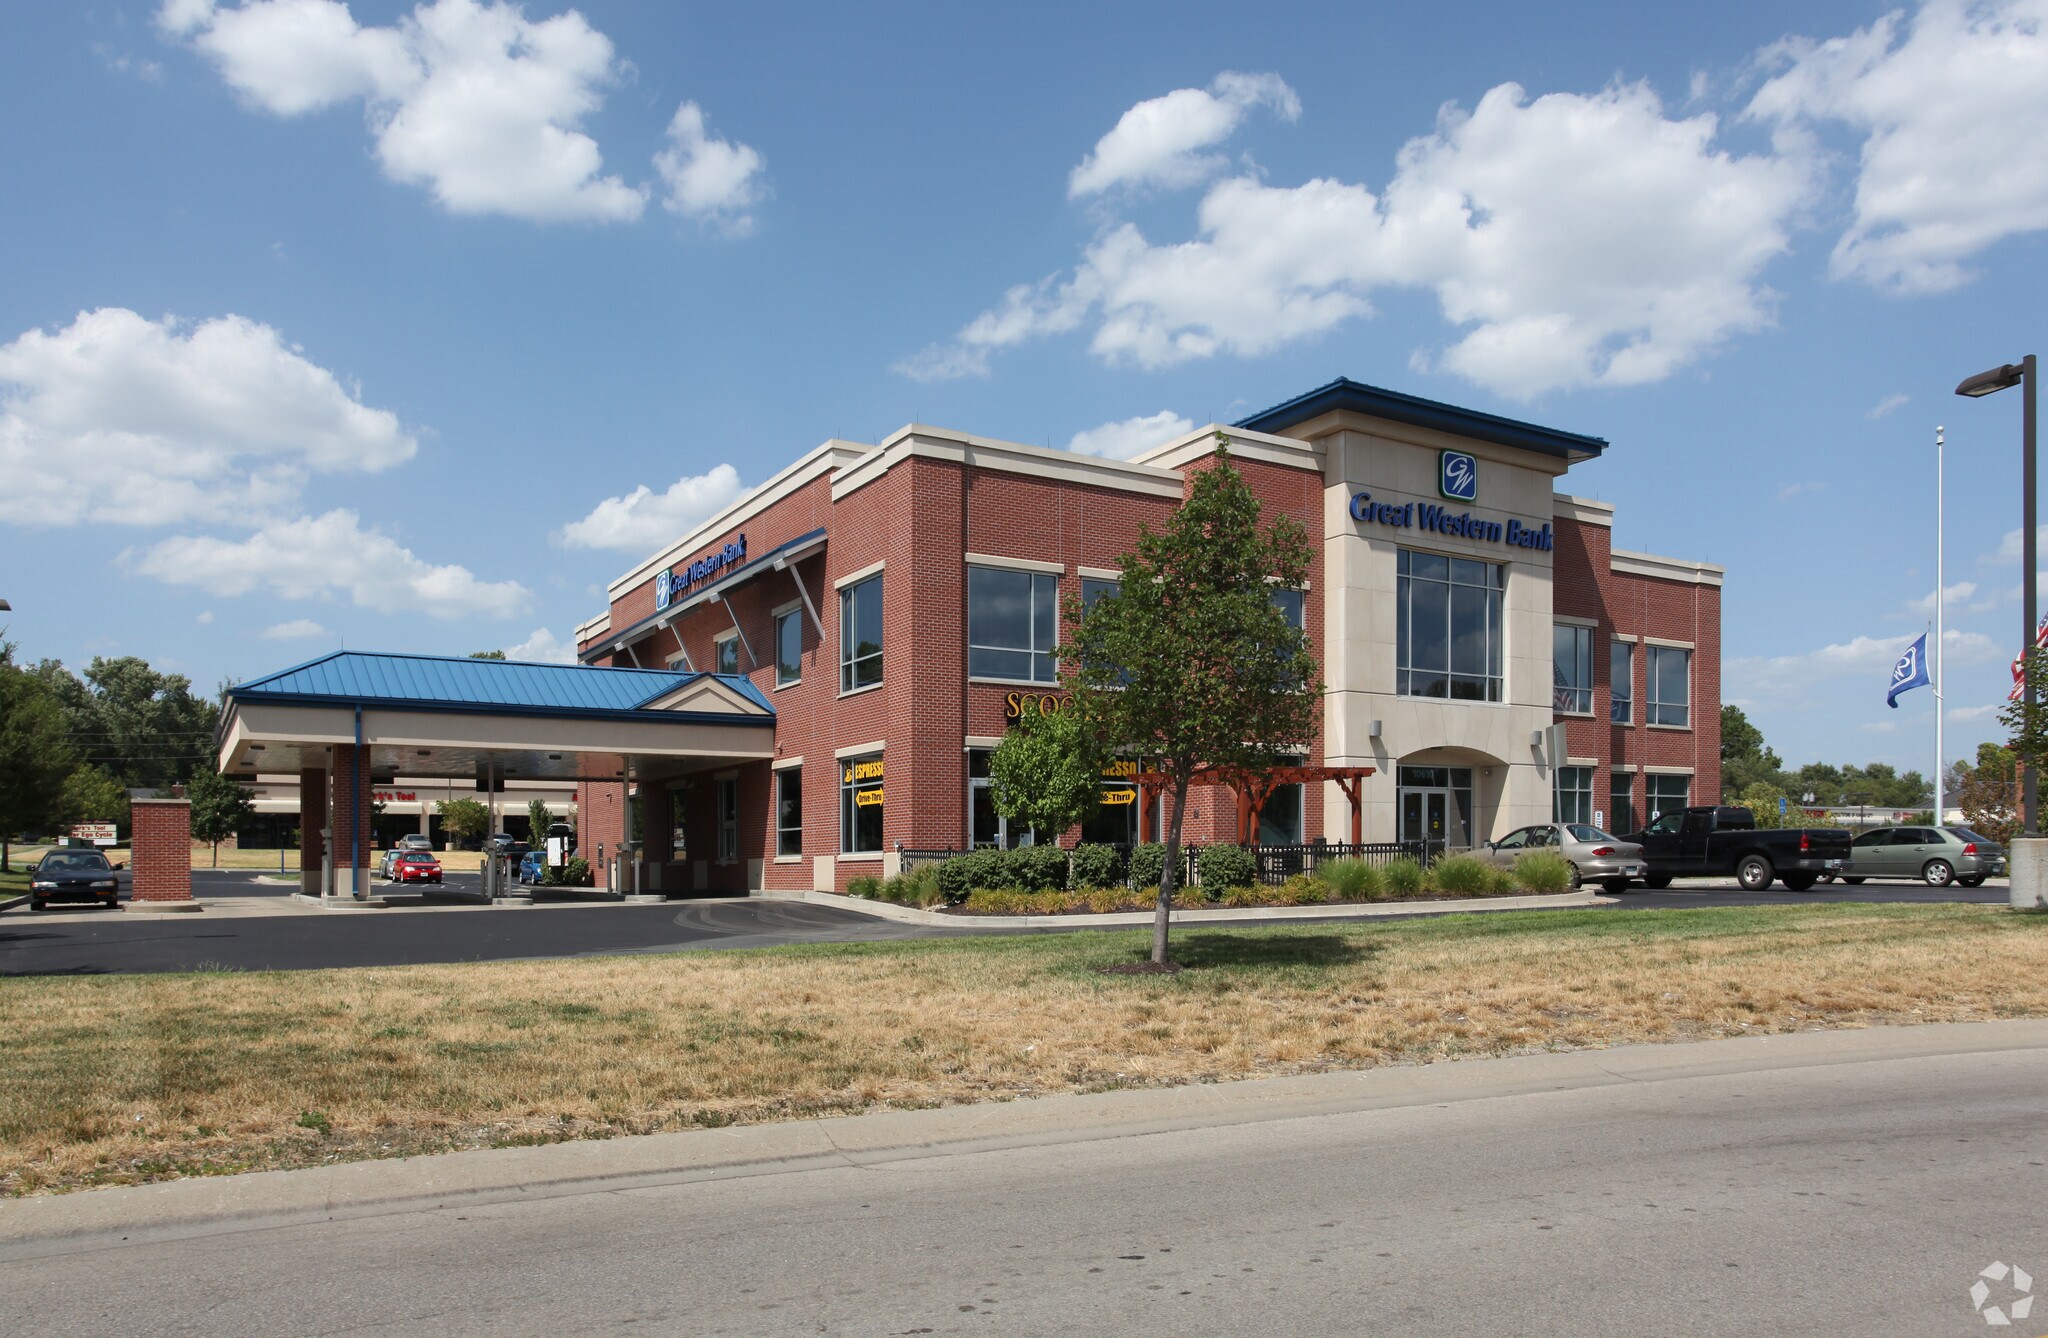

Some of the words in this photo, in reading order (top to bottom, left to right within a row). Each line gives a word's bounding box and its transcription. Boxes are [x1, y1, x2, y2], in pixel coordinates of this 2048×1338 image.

[1350, 492, 1413, 528] Great
[1417, 502, 1502, 542] Western
[1505, 518, 1553, 551] Bank
[669, 571, 689, 595] Great
[689, 554, 721, 583] Western
[722, 533, 745, 564] Bank
[396, 791, 416, 800] Tool
[858, 793, 882, 803] Drive-Thru
[1102, 792, 1131, 802] e-Thru
